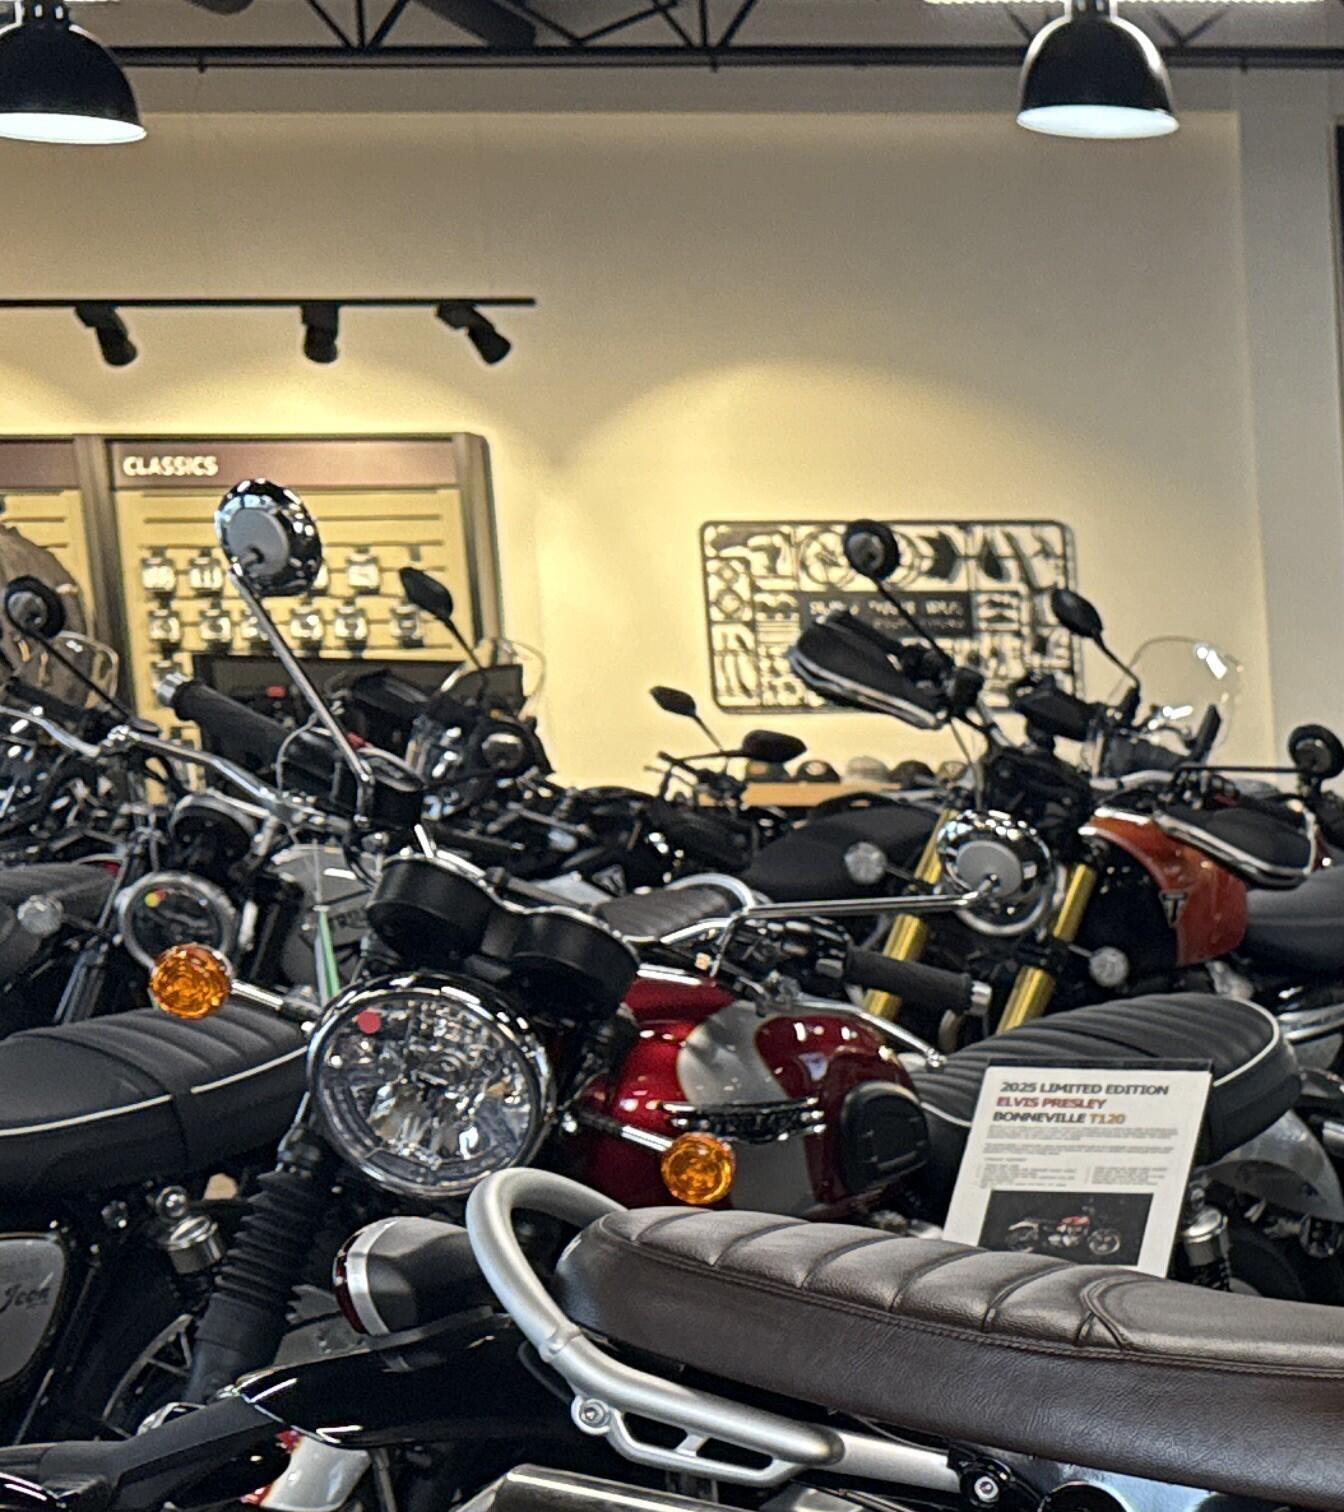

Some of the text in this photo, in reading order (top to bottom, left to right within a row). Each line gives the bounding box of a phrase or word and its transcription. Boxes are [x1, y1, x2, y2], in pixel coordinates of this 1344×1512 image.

[123, 455, 219, 476] CLASSICS
[1000, 1081, 1169, 1096] 2025 LIMITED EDITION
[995, 1096, 1108, 1110] ELVIS PRESLEY
[992, 1111, 1127, 1125] BONNEVILLE T120
